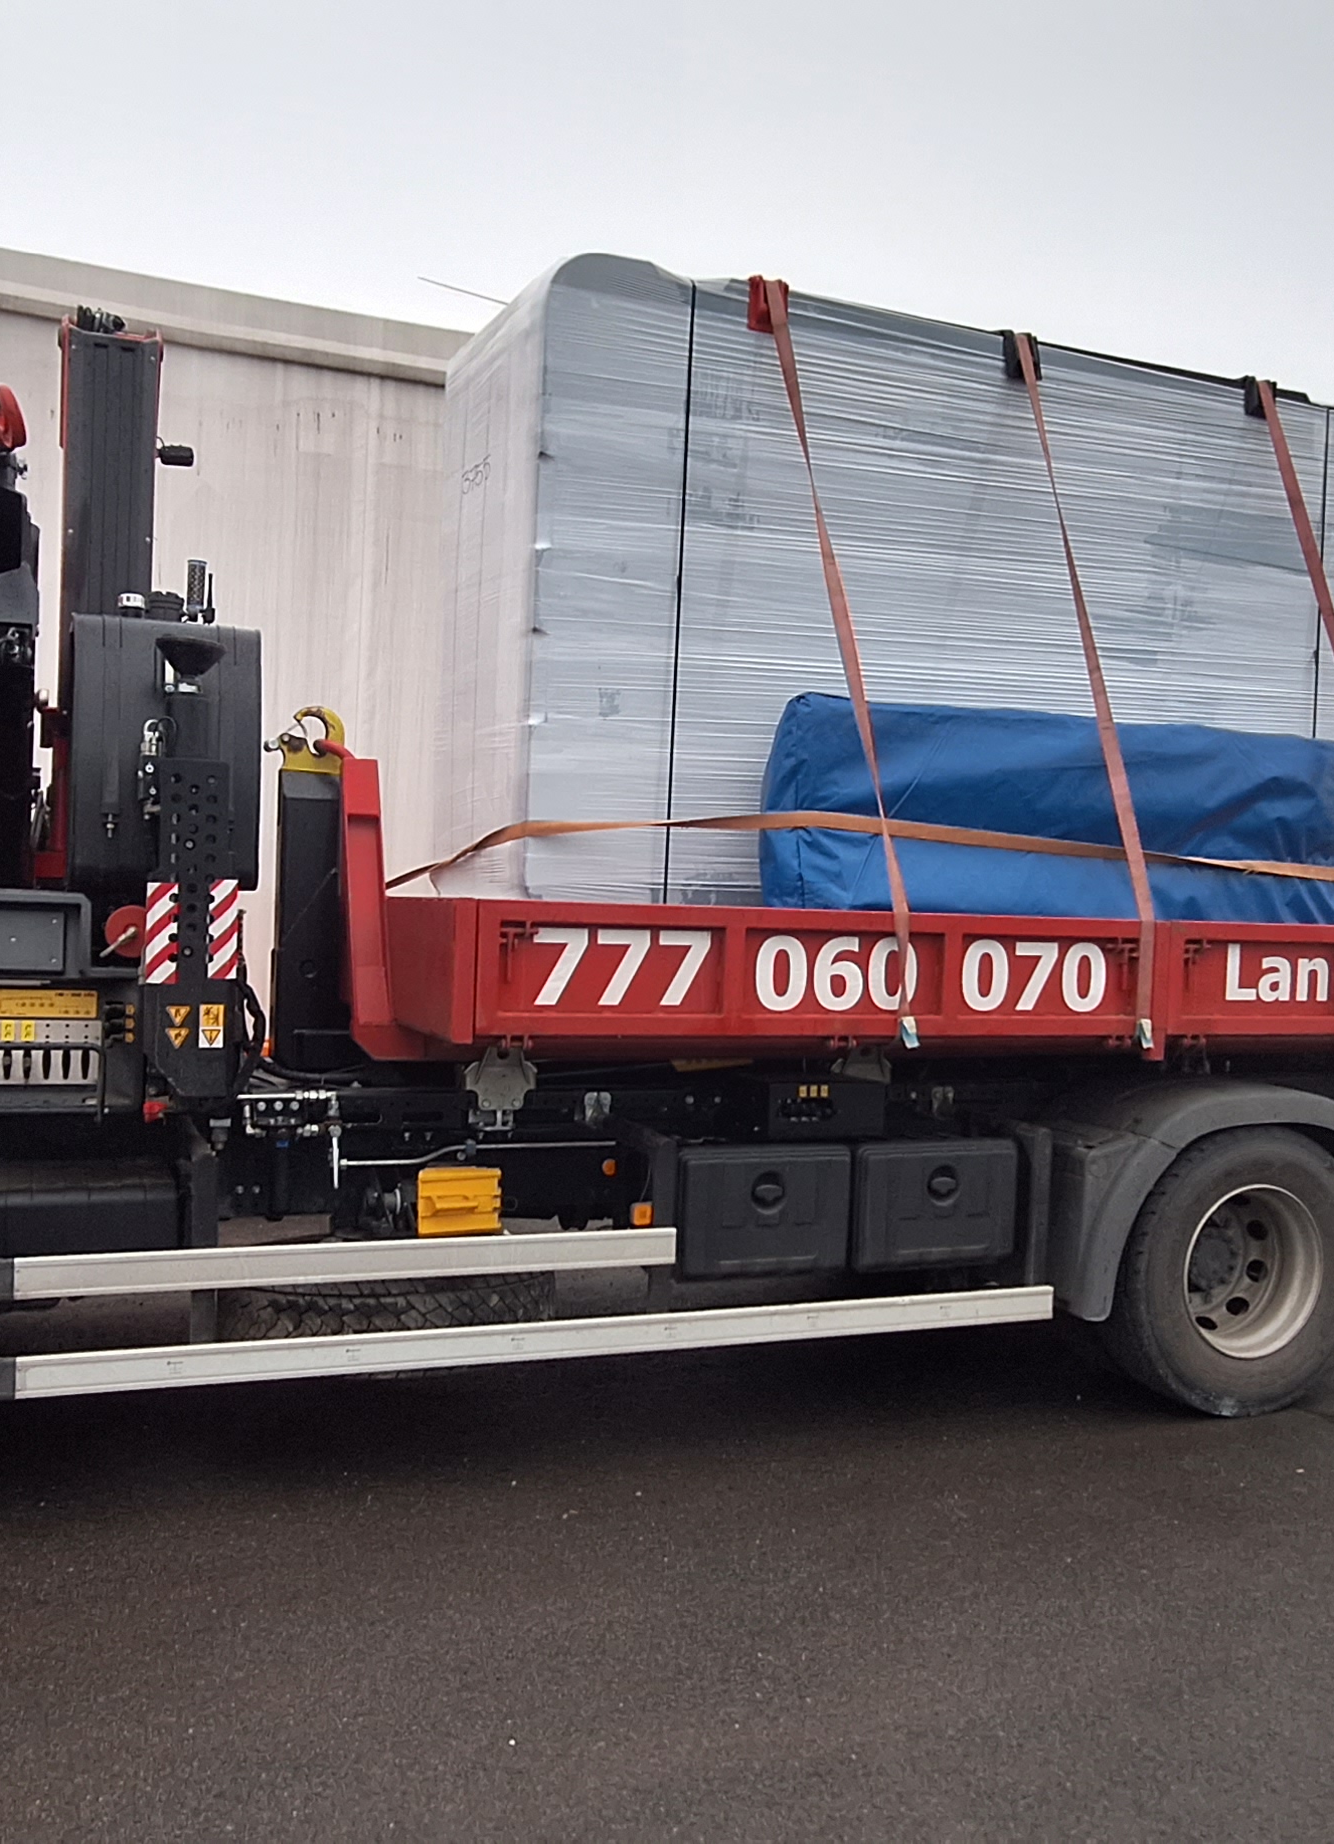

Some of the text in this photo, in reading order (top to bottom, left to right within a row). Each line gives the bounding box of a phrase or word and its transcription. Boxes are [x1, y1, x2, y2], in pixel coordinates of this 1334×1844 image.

[533, 927, 1107, 1013] 777 060 070
